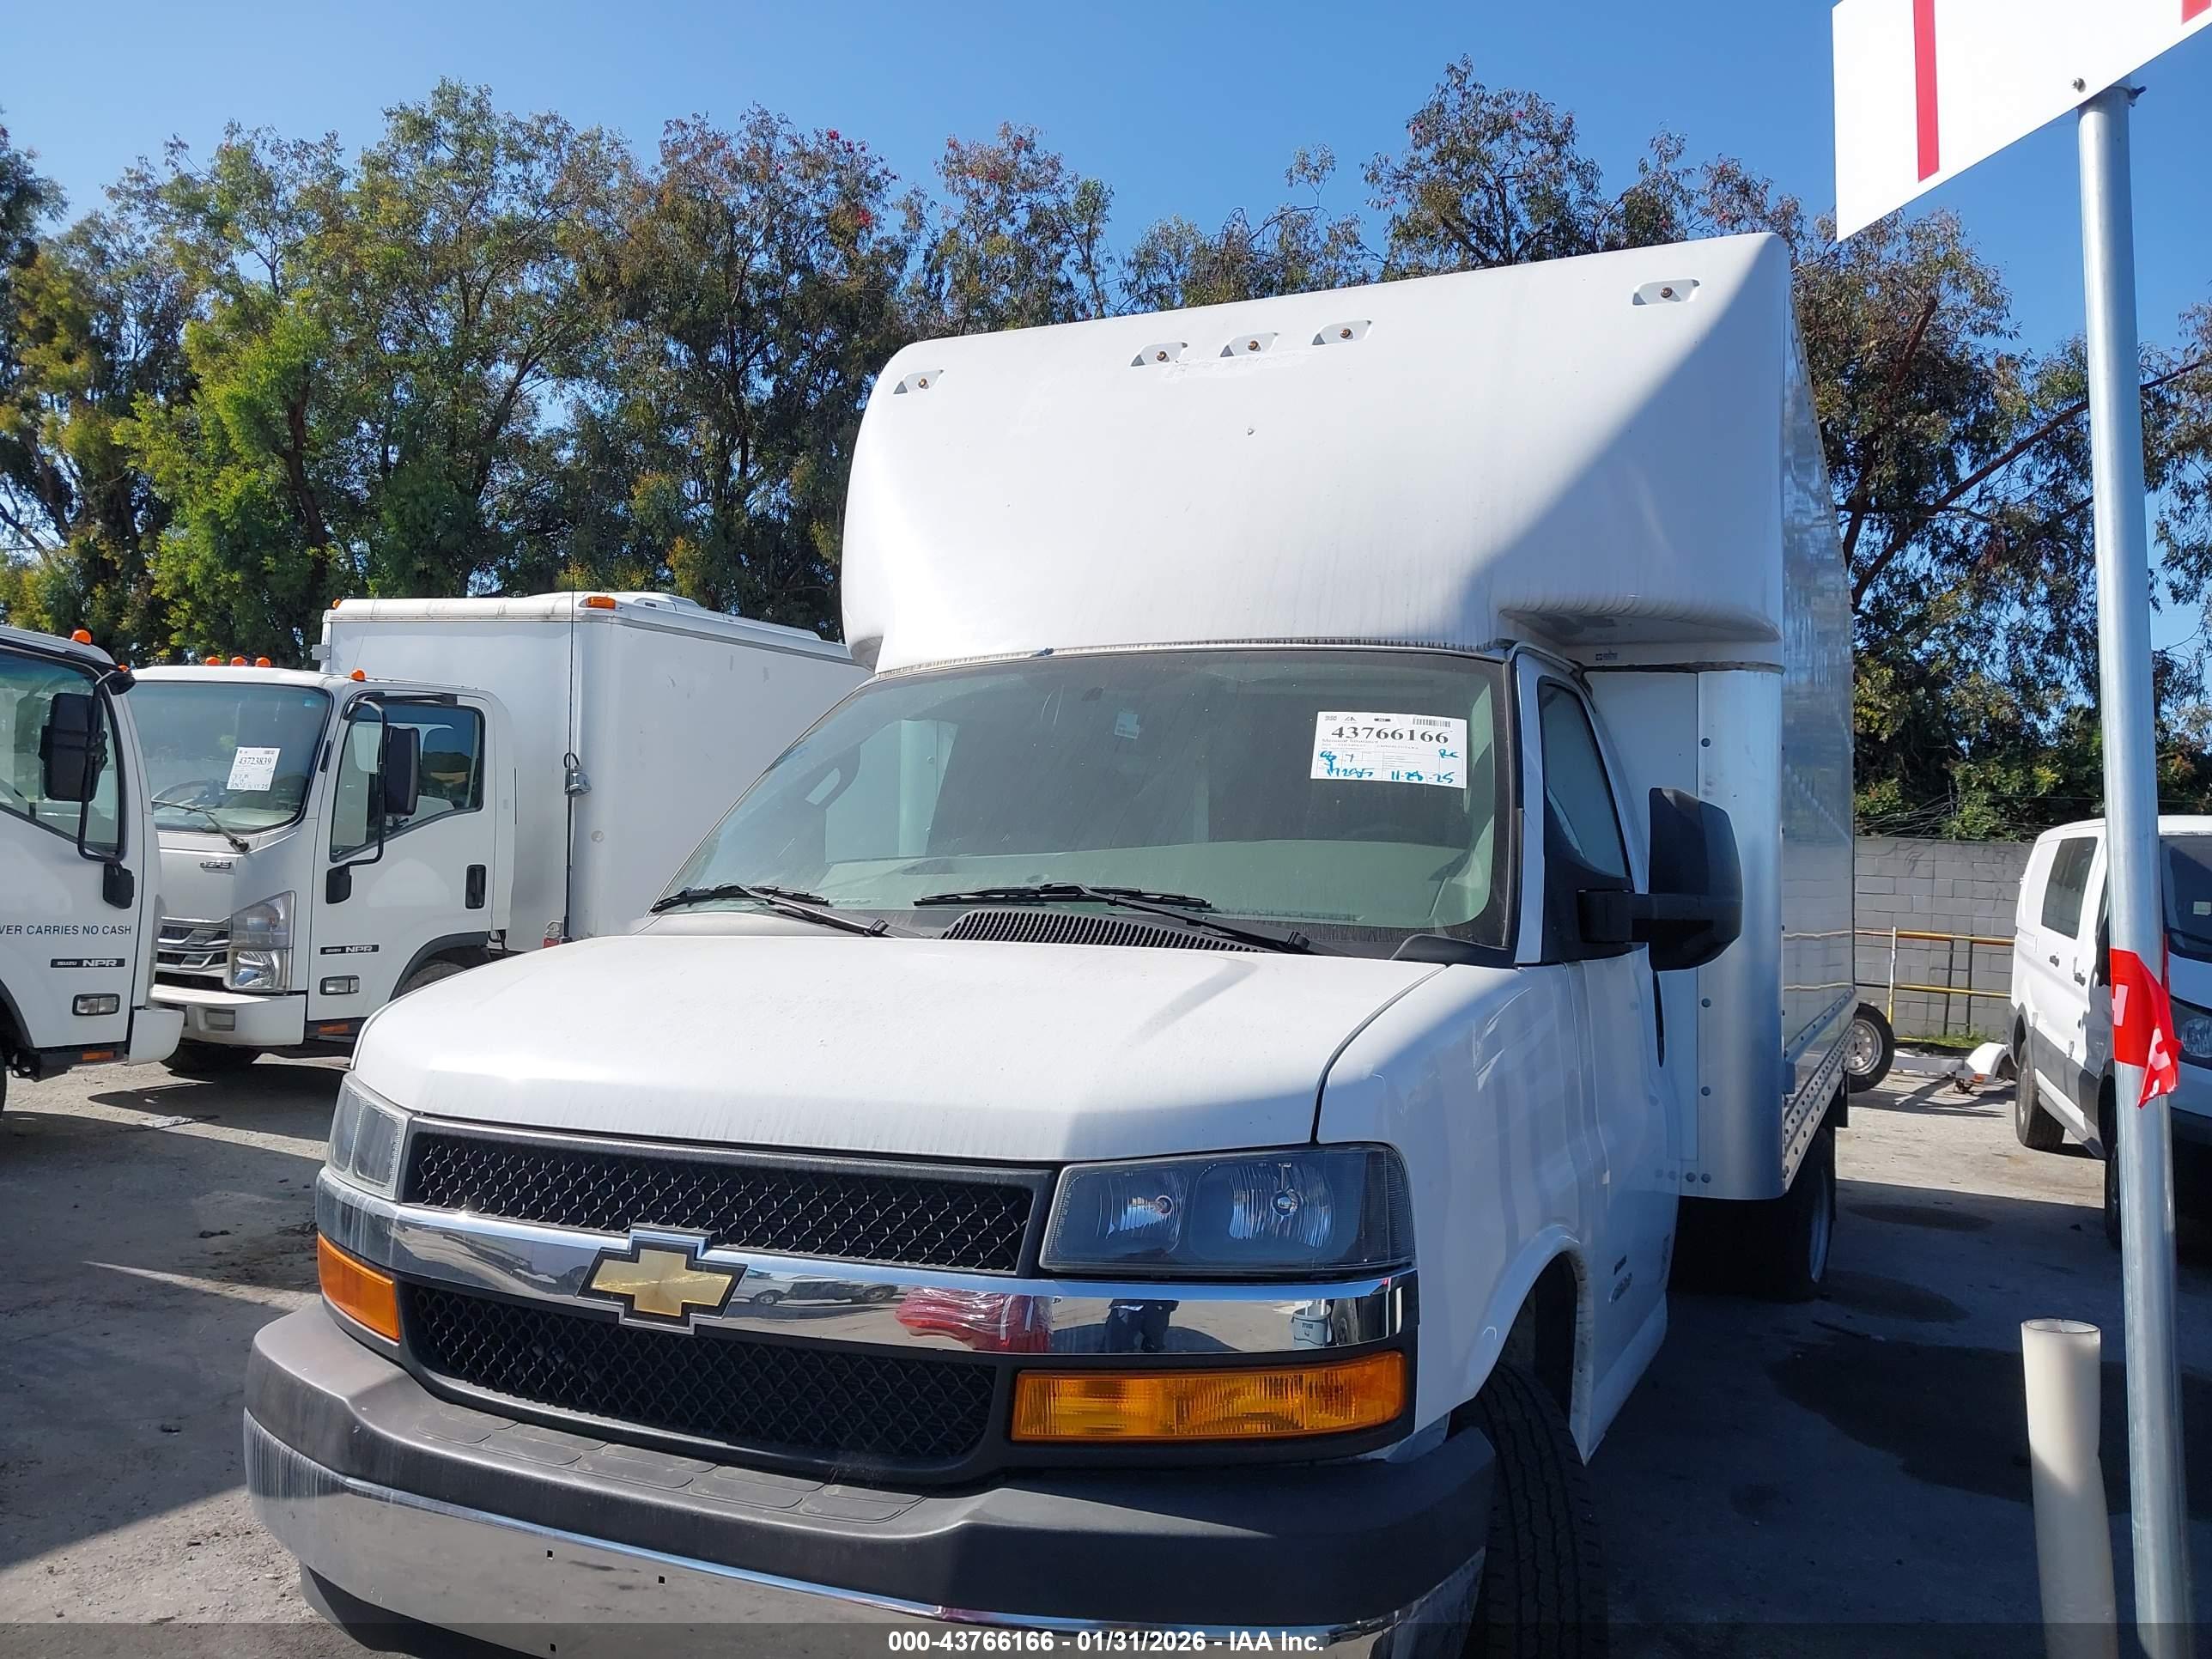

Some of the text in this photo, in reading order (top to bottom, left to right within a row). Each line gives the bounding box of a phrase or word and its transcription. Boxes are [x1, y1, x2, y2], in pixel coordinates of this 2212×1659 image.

[1331, 726, 1449, 744] 43766166
[27, 925, 79, 935] CARRIES
[82, 925, 99, 935] NO
[102, 925, 131, 935] CASH
